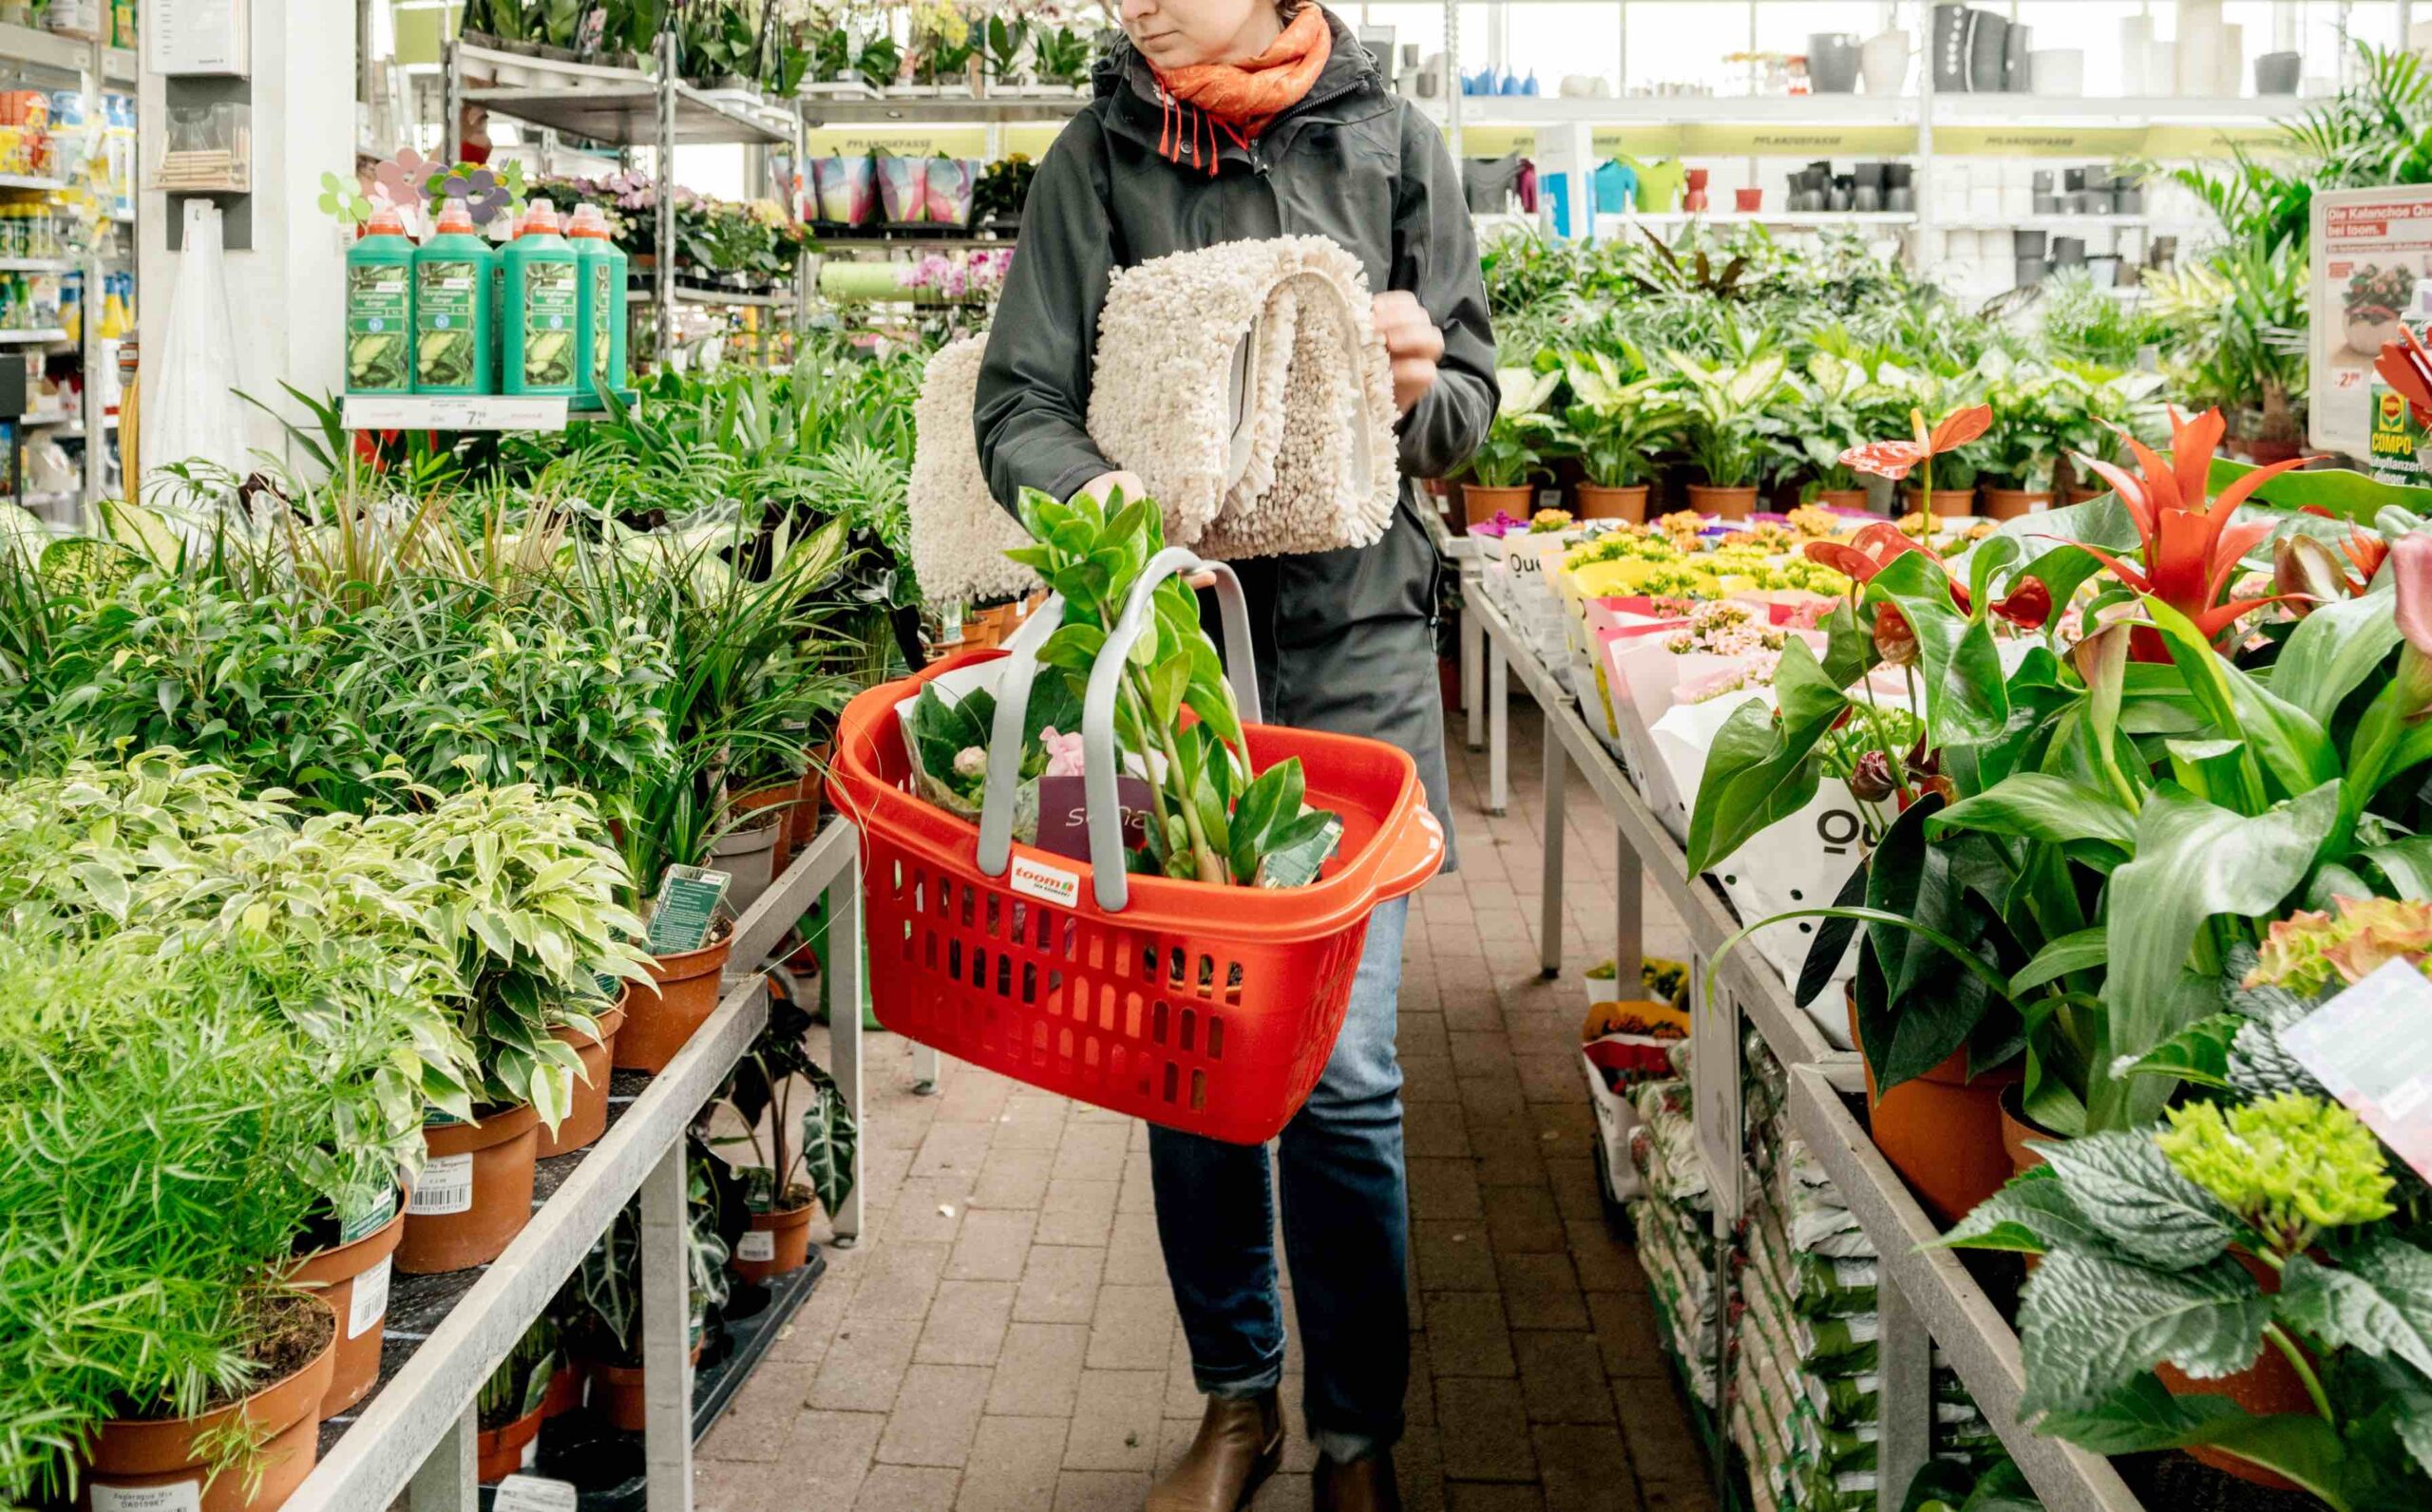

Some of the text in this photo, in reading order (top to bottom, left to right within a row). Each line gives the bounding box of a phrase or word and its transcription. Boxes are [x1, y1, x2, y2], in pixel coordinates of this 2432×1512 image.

[2349, 206, 2410, 219] Kalanchoe
[2328, 225, 2345, 236] bei
[2371, 433, 2411, 455] COMPO
[1016, 866, 1060, 888] toom
